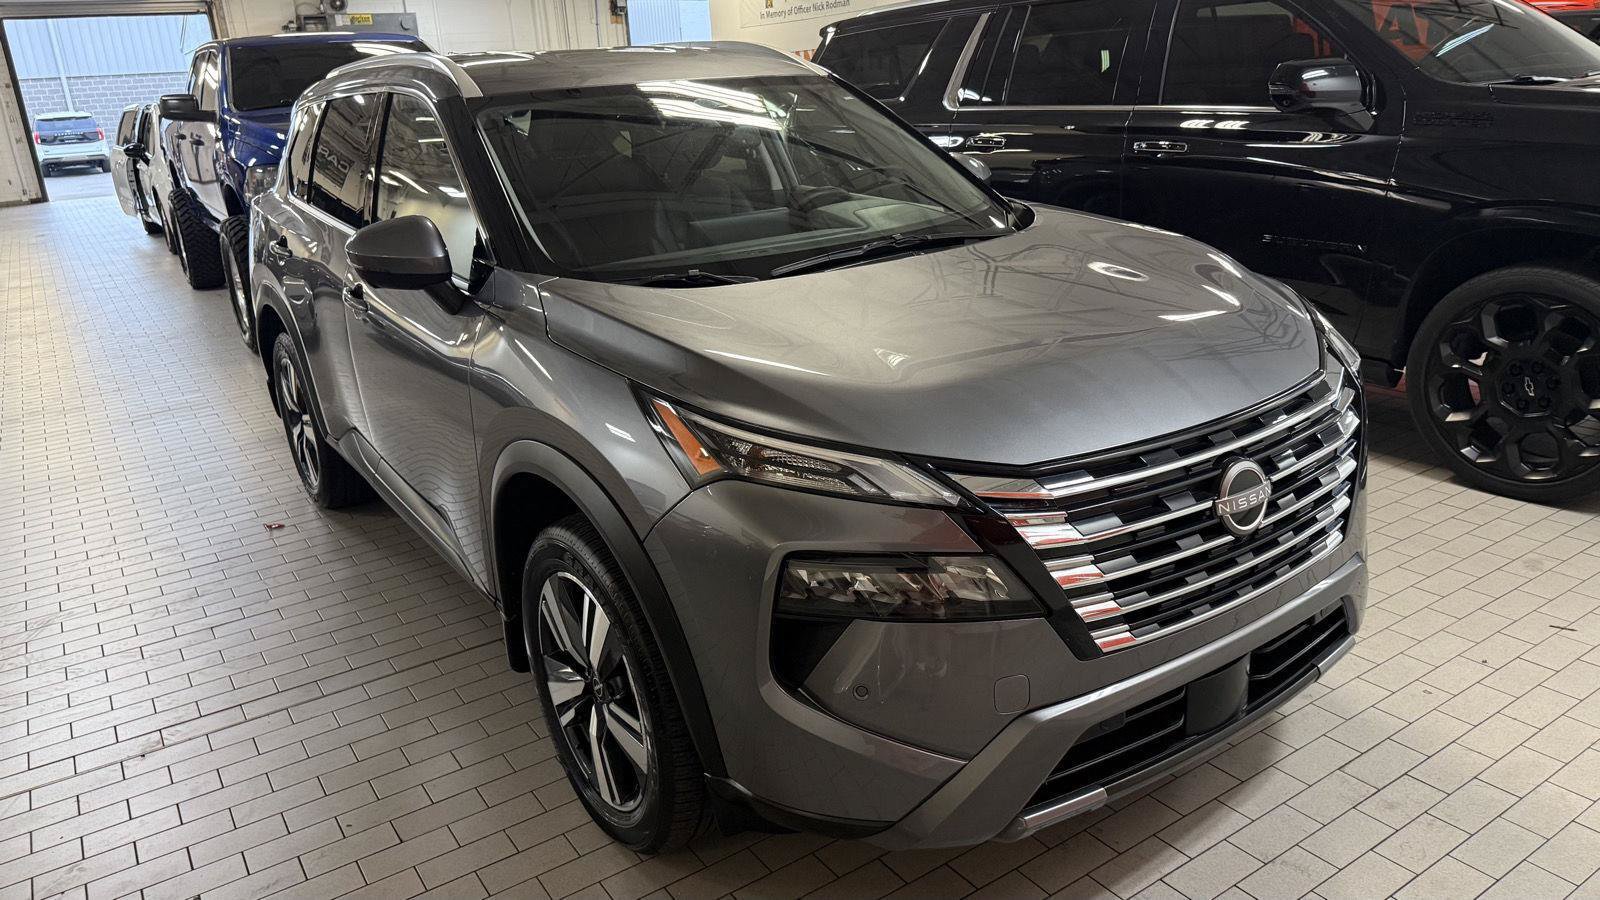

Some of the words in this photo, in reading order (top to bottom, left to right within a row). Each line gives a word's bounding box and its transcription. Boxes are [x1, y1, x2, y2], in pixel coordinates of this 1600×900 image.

[766, 10, 787, 18] Memory
[787, 7, 794, 16] of
[794, 5, 812, 14] Officer
[812, 2, 825, 12] Nick
[826, 0, 850, 10] Rodman
[1218, 485, 1271, 514] NISSAN
